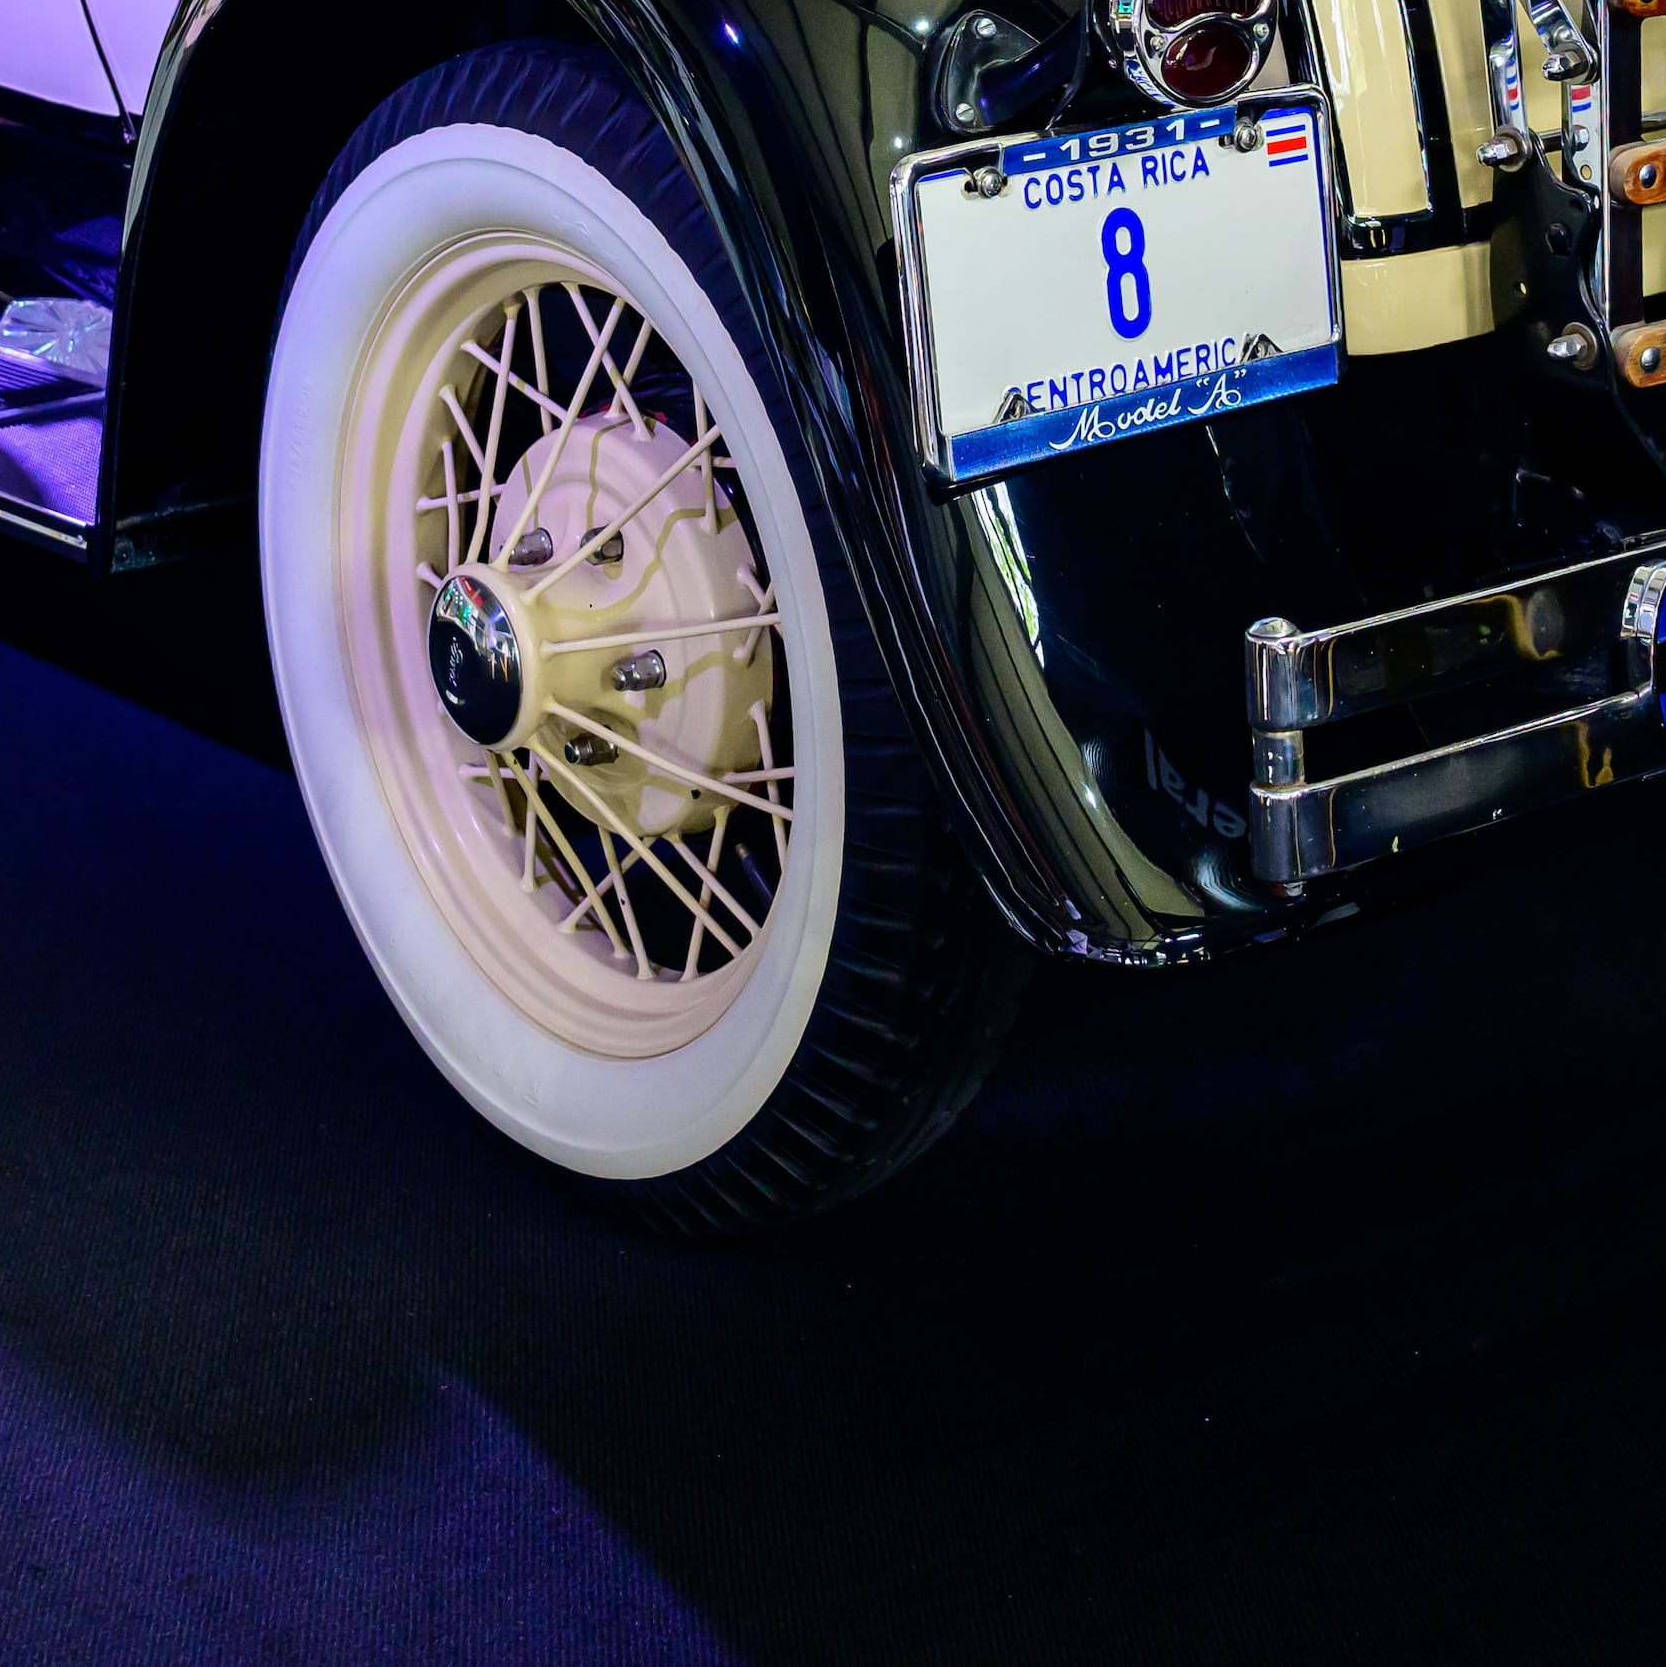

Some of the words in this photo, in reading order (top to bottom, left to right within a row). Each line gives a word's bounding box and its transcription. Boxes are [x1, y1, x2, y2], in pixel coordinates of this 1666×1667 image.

[1023, 162, 1126, 210] COSTA
[1141, 146, 1210, 188] RICA
[1101, 207, 1152, 339] 8
[1003, 337, 1238, 411] ENTROAMERIC
[1049, 388, 1182, 451] Model
